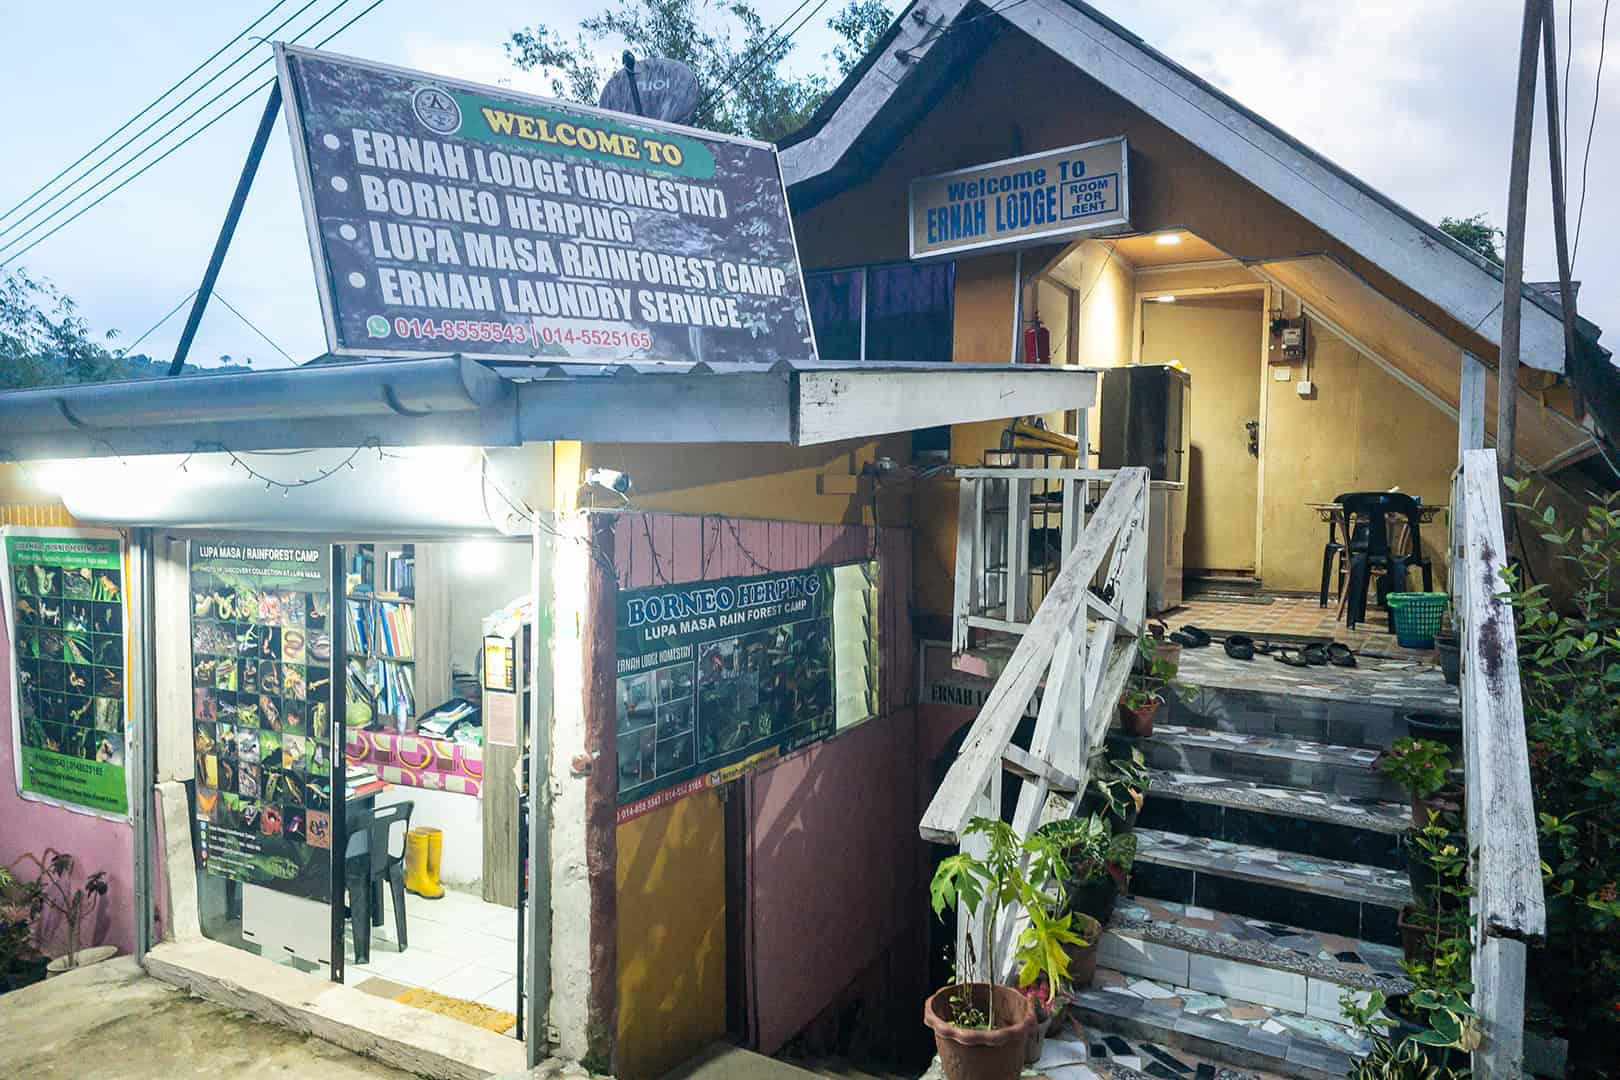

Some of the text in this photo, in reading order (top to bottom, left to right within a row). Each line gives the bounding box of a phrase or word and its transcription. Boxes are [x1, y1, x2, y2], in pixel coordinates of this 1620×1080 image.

[482, 107, 684, 167] WELCOME TO
[352, 128, 728, 218] ERNAH LODGE (HOMESTAY)
[947, 167, 1047, 202] Welcome
[1070, 178, 1109, 195] ROOM
[360, 174, 633, 243] BORNEO HERPING
[927, 185, 1057, 244] ERNAH LODGE
[1071, 200, 1106, 215] RENT
[1076, 191, 1103, 203] FOR
[369, 221, 785, 297] LUPA MASA RAINFOREST CAMP
[378, 268, 742, 329] ERNAH LAUNDRY SERVICE
[395, 318, 526, 343] 014-8555543
[542, 328, 651, 349] 014-5525165
[199, 545, 218, 558] LUPA
[219, 546, 241, 559] MASA
[246, 547, 294, 561] RAINFOREST
[295, 550, 319, 562] CAMP
[627, 575, 821, 628] BORNEO HERPING
[644, 599, 807, 641] LUPA MASA RAIN FOREST CAMP
[617, 655, 641, 673] ERNAH
